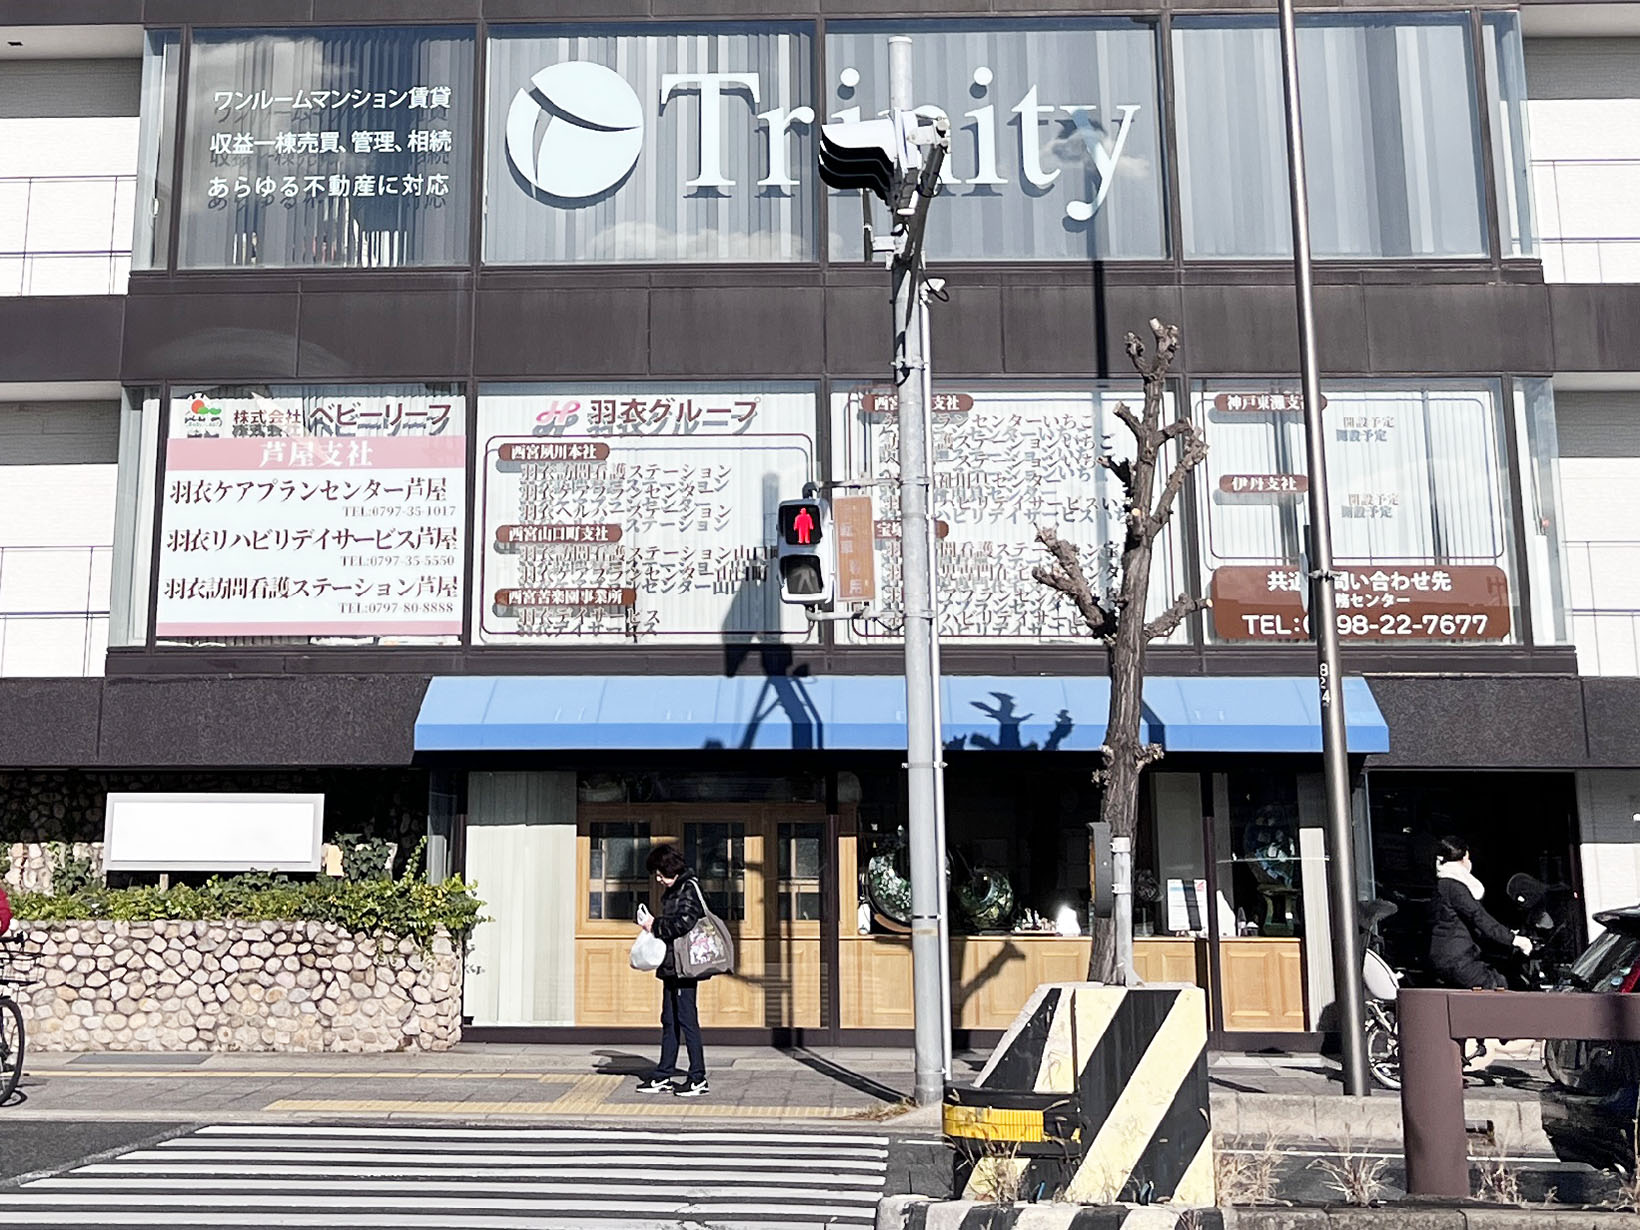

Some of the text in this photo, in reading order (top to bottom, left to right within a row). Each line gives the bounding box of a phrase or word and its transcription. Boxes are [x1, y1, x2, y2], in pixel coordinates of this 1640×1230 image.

[214, 86, 451, 111] ワンルームマンション賃貸
[207, 173, 449, 198] あらゆる不動産に対応
[590, 396, 761, 425] 羽衣グループ
[875, 395, 961, 410] 西宮支社
[1343, 416, 1395, 429] 開設予定
[259, 440, 374, 467] 芦屋支社
[511, 445, 597, 460] 西宮夙川本社
[521, 462, 732, 481] 羽衣訪問看護ステーション
[170, 477, 447, 504] 羽衣ケアプランセンター芦屋
[1232, 476, 1297, 491] 伊丹支社
[1348, 493, 1399, 506] 開設予定
[167, 526, 457, 552] 羽衣リハビリデイサービス芦屋
[508, 526, 609, 542] 西宮山口町支社
[164, 575, 458, 600] 羽衣訪問看護ステーション芦屋
[1267, 571, 1452, 592] 共通問い合わせ先
[339, 602, 453, 613] TEL:0797-80-8888
[1334, 593, 1411, 609] 務センター
[519, 607, 660, 626] 羽衣デイサービス
[1242, 614, 1488, 635] TEL:98-22-7677
